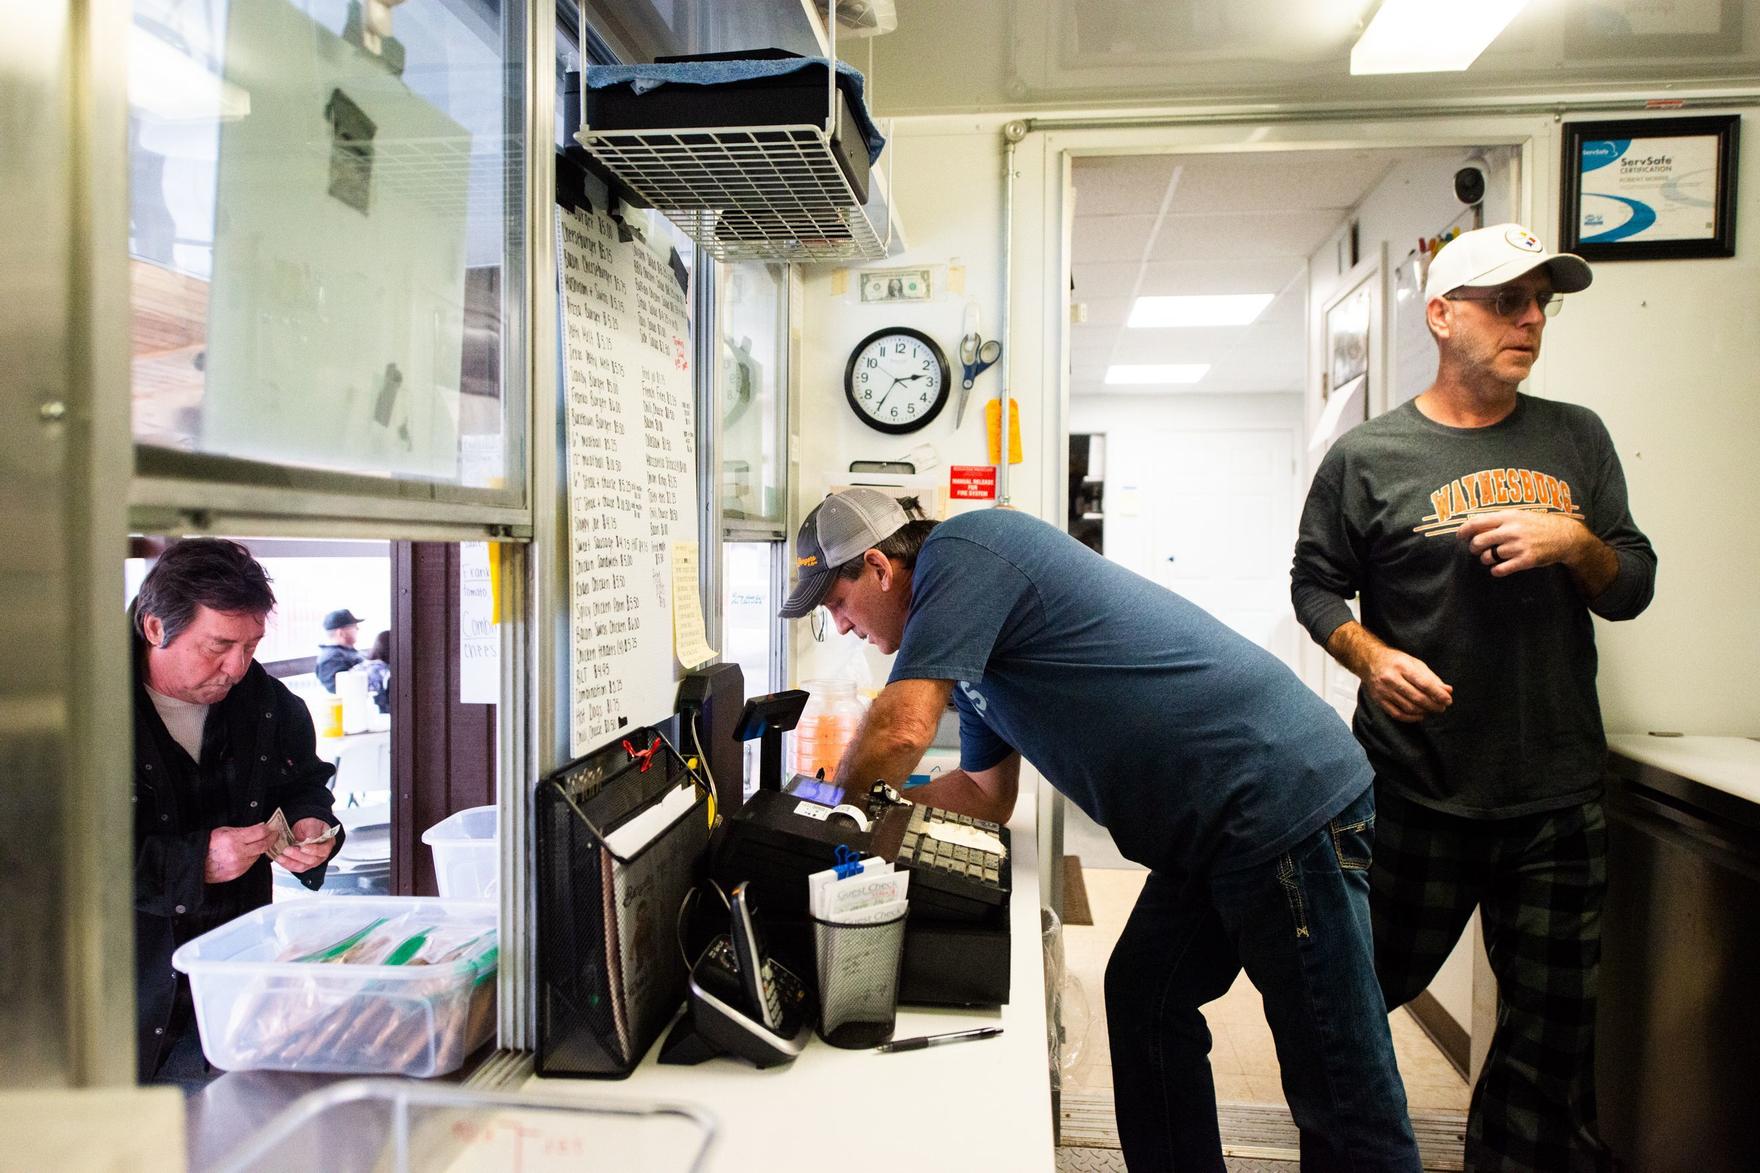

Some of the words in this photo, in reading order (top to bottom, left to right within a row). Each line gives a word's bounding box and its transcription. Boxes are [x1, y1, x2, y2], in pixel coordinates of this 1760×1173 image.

[1621, 155, 1672, 167] ServSafe
[1620, 166, 1672, 174] CERTIFICATION
[880, 347, 886, 357] 11
[895, 343, 906, 354] 12
[912, 348, 917, 358] 1
[866, 358, 878, 368] 10
[922, 360, 931, 370] 2
[861, 372, 868, 383] 9
[925, 377, 934, 387] 3
[864, 389, 872, 400] 8
[920, 392, 927, 402] 4
[875, 401, 883, 412] 7
[890, 406, 898, 417] 6
[907, 403, 915, 414] 5
[1430, 468, 1573, 523] WAYNESBURG
